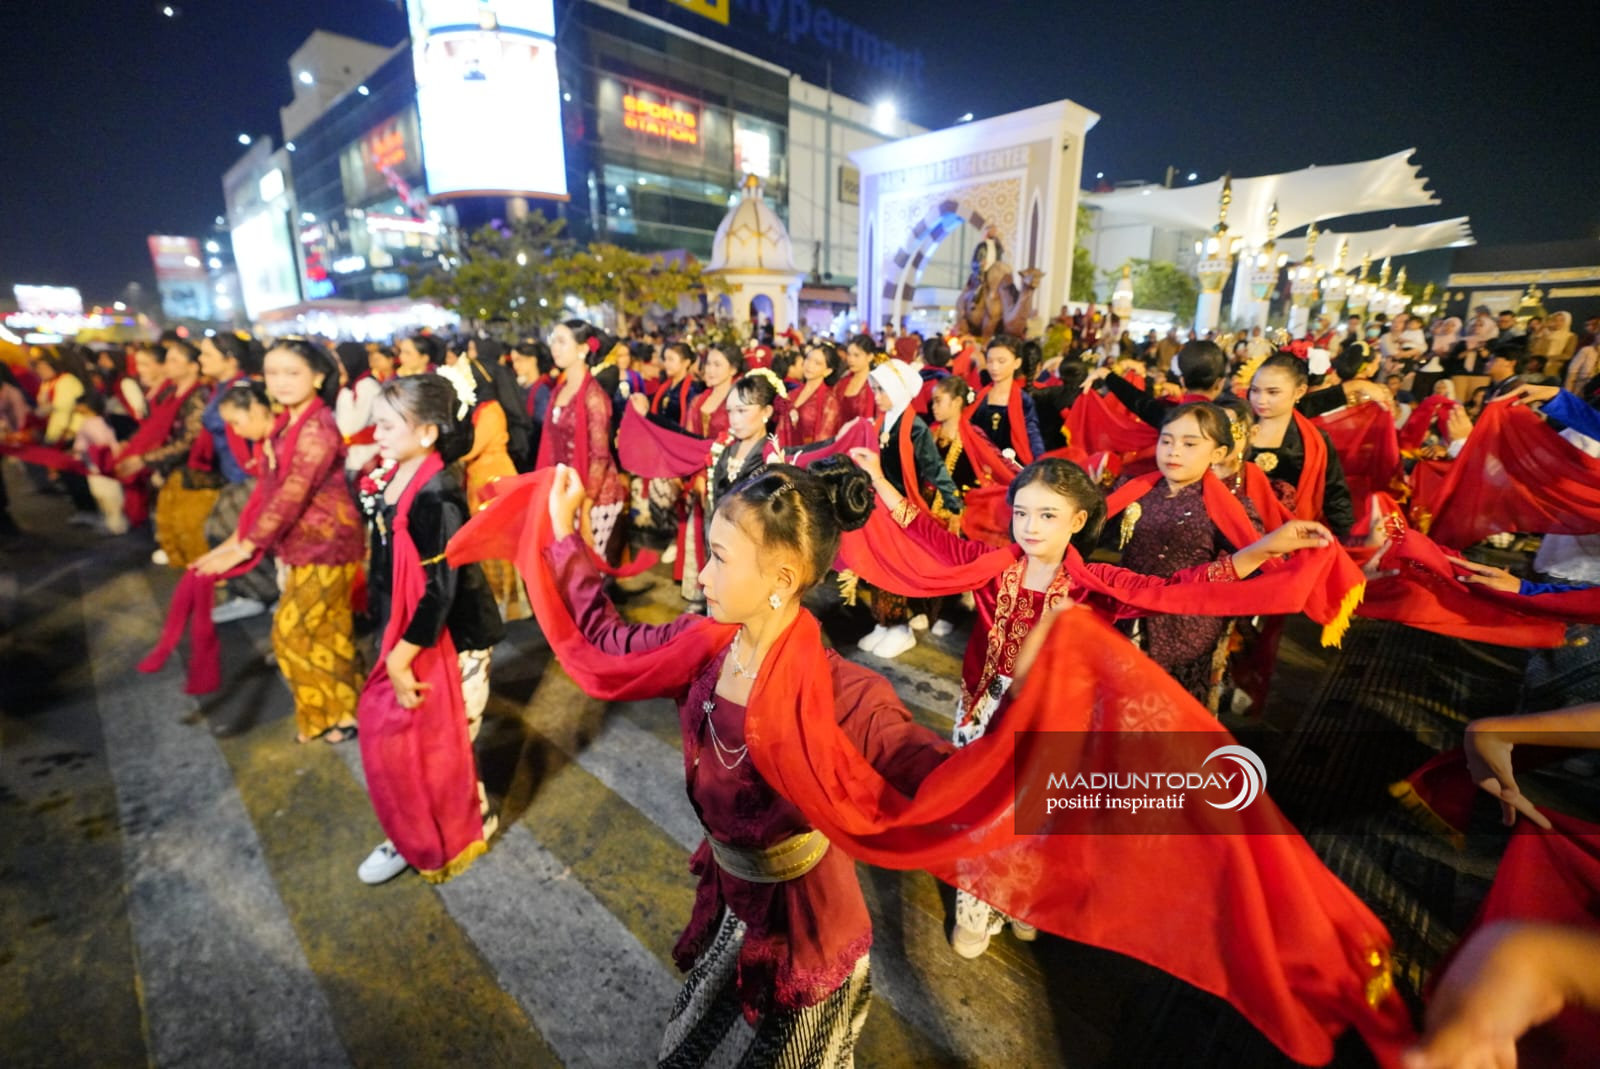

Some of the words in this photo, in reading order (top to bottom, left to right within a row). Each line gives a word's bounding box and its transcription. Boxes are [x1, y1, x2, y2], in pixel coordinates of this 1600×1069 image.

[734, 0, 926, 82] ypermart
[623, 93, 697, 129] SPORTS
[623, 113, 697, 145] STATION
